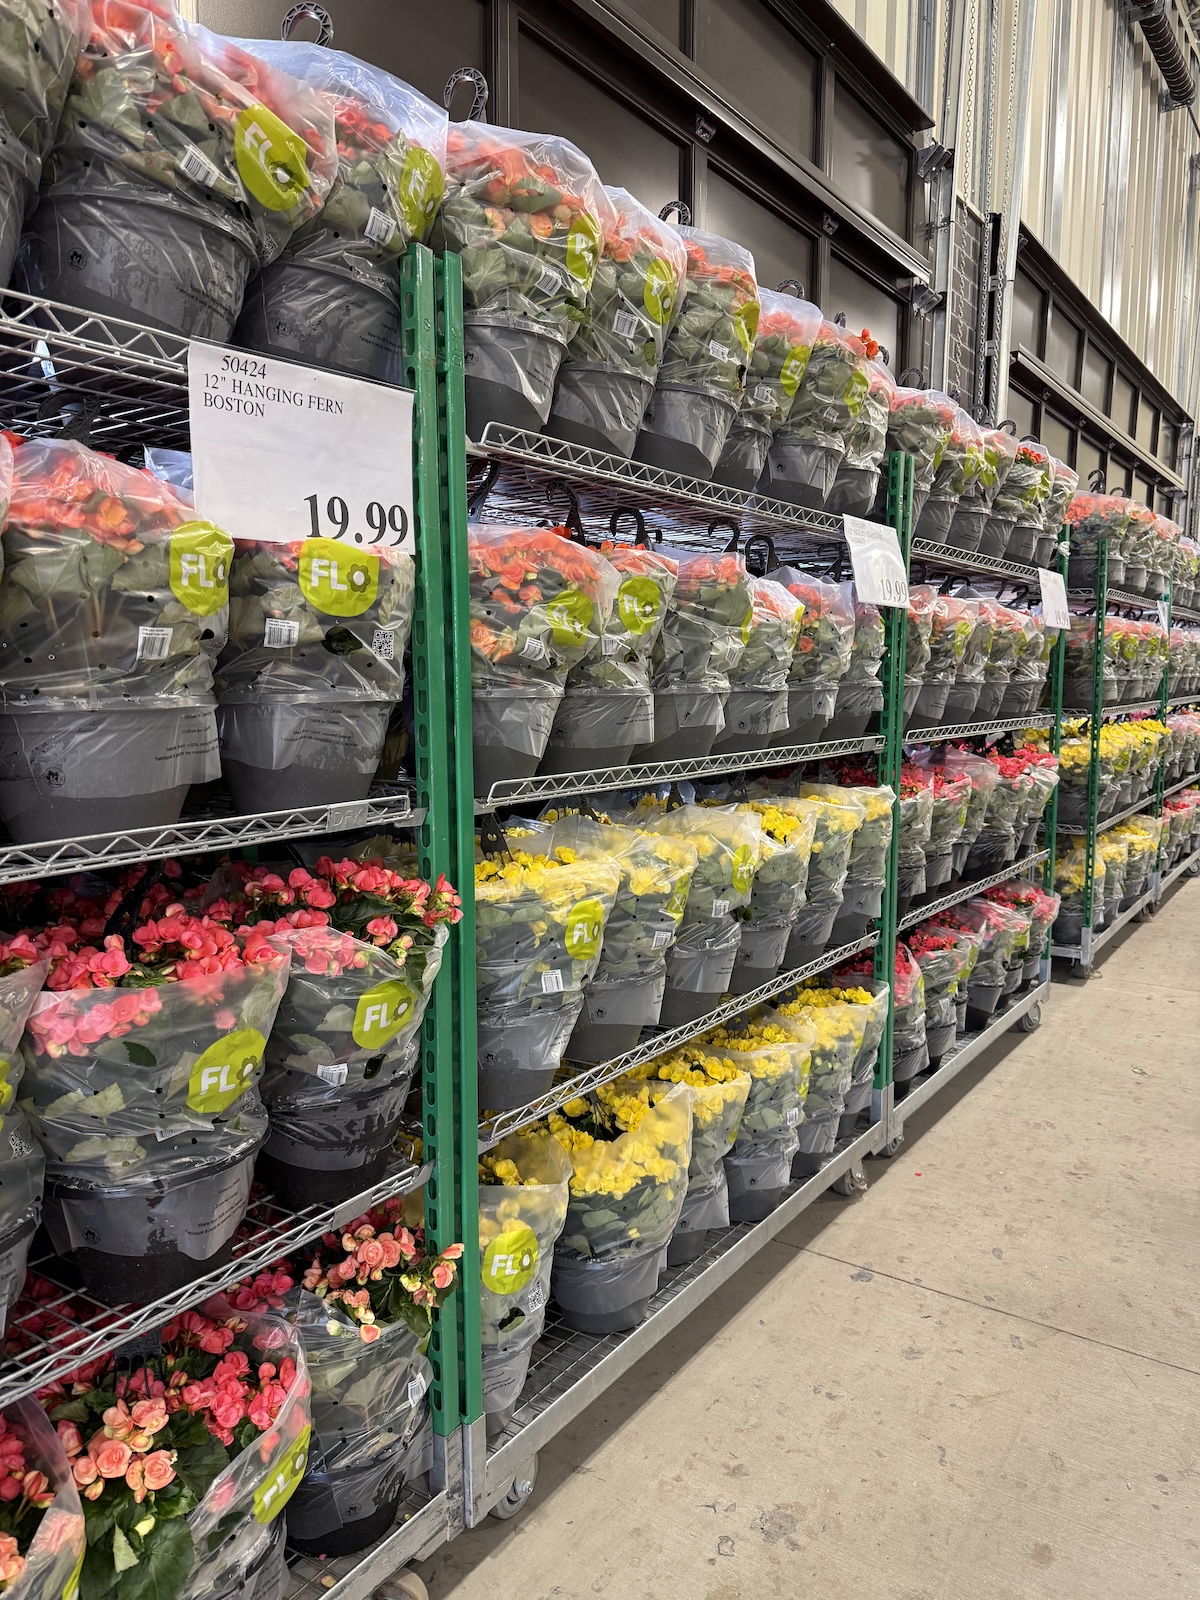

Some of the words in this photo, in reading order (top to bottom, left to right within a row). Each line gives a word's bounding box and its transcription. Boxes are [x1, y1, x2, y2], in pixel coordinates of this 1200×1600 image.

[221, 355, 267, 379] 50424
[203, 392, 265, 417] BOSTON
[204, 373, 226, 390] 12"
[231, 378, 303, 407] HANGING
[307, 394, 344, 415] FERN
[303, 493, 409, 547] 19.99
[880, 578, 908, 604] 19.99
[364, 996, 412, 1032] FLO
[201, 1055, 258, 1096] FLO
[490, 1248, 534, 1277] FLO
